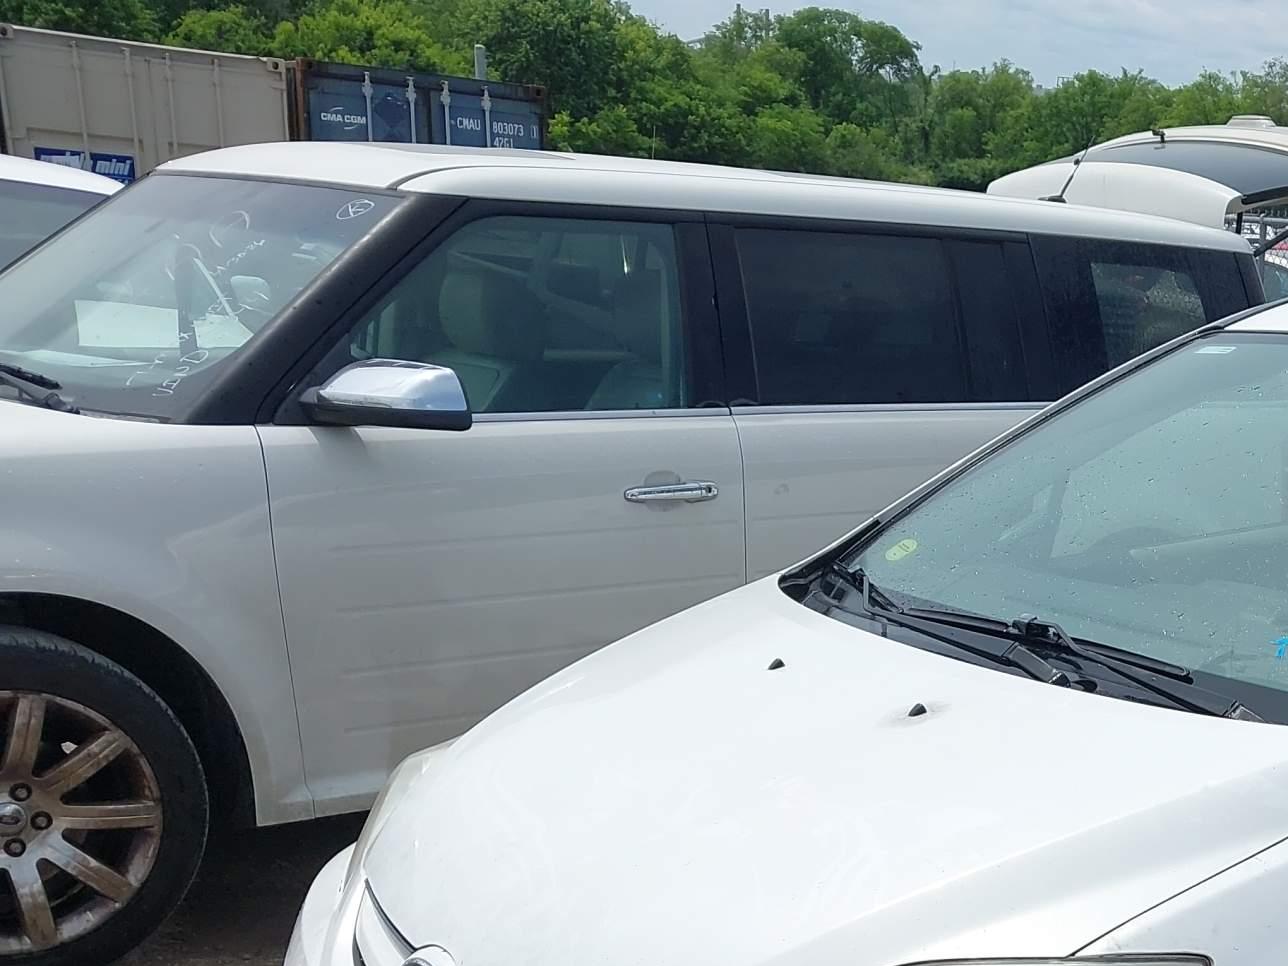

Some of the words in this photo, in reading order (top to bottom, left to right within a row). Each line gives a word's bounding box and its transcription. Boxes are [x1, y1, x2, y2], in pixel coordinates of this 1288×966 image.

[320, 111, 343, 122] CMA
[344, 114, 367, 125] CGM
[457, 117, 481, 131] CMAU
[492, 121, 524, 136] 803073
